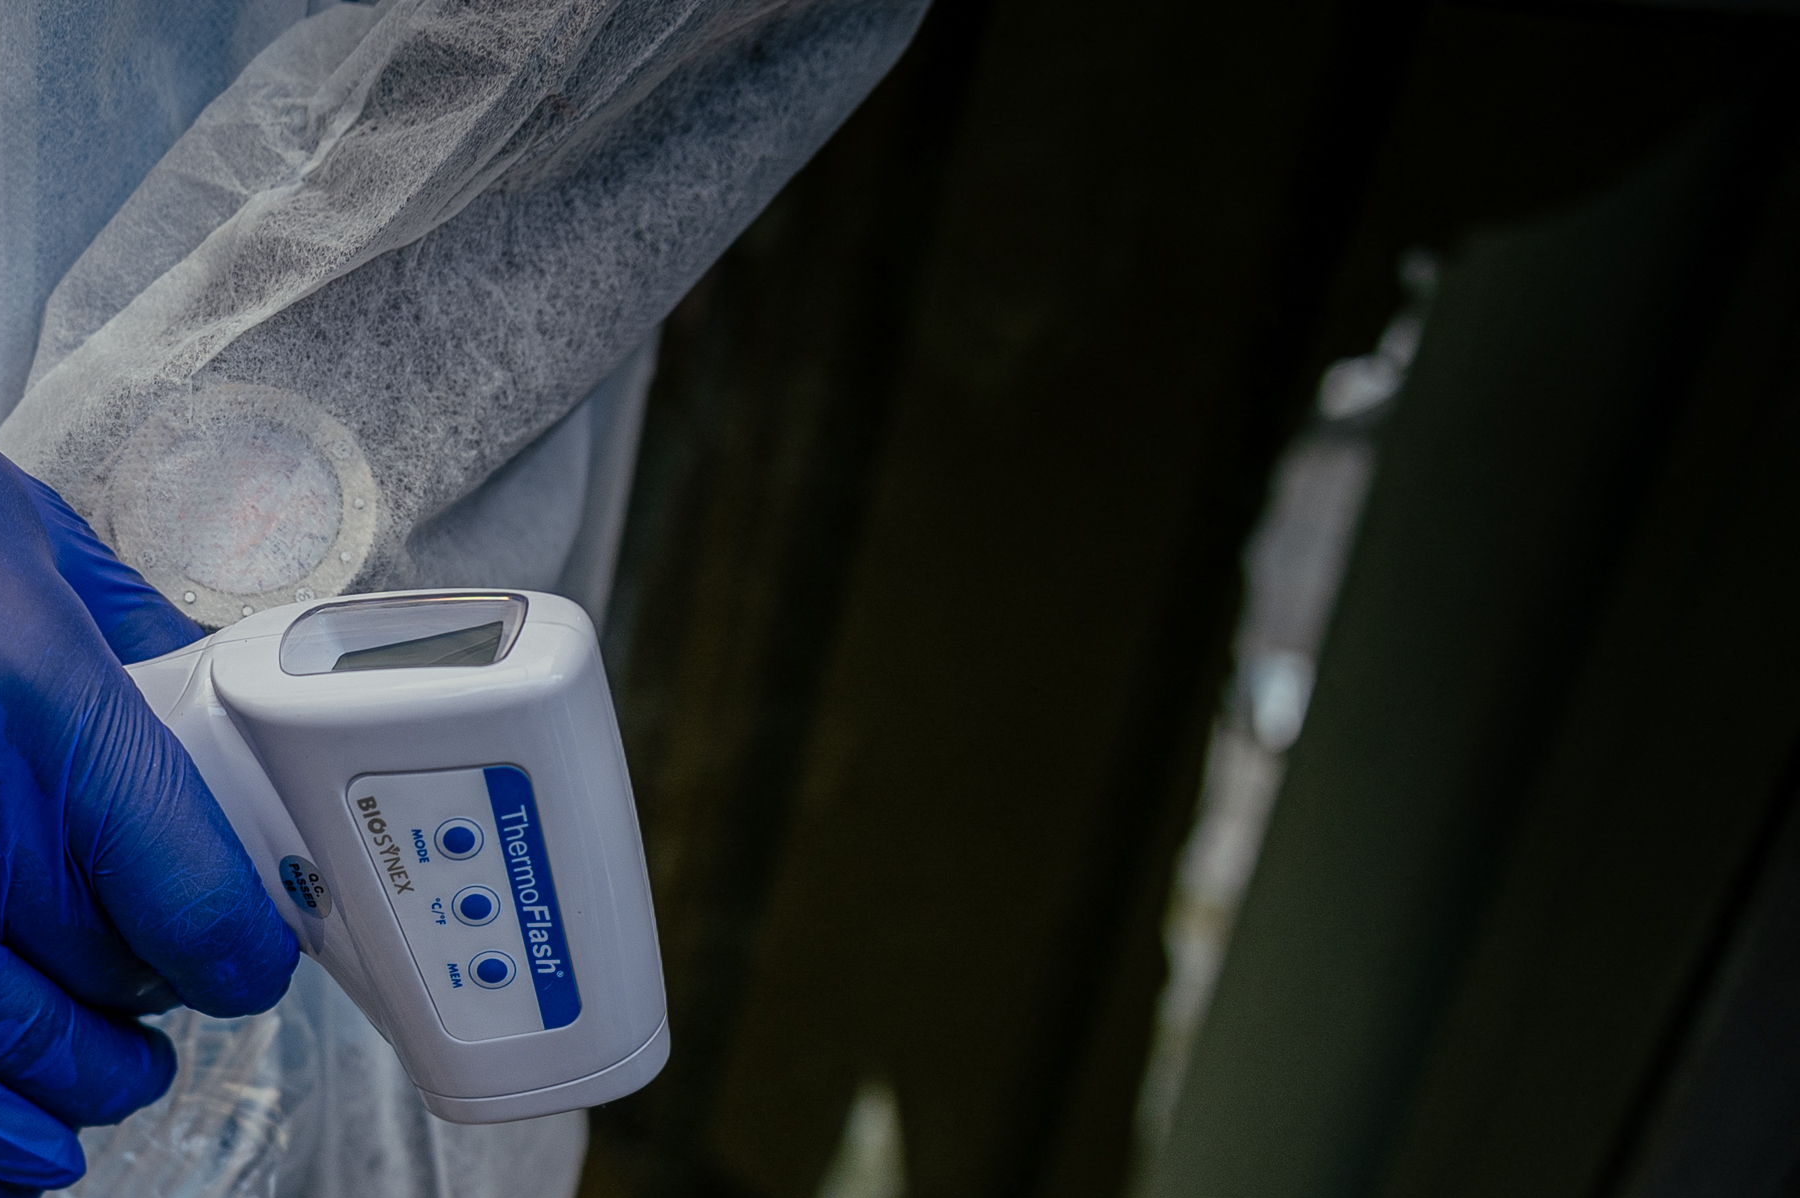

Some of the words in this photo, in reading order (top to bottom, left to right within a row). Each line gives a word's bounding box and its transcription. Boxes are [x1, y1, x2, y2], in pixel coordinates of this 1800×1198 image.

[357, 795, 414, 895] BIOSYNEX
[411, 828, 430, 863] MODE
[288, 862, 317, 908] PASSED
[308, 872, 325, 898] Q.C.
[447, 963, 463, 989] MEM
